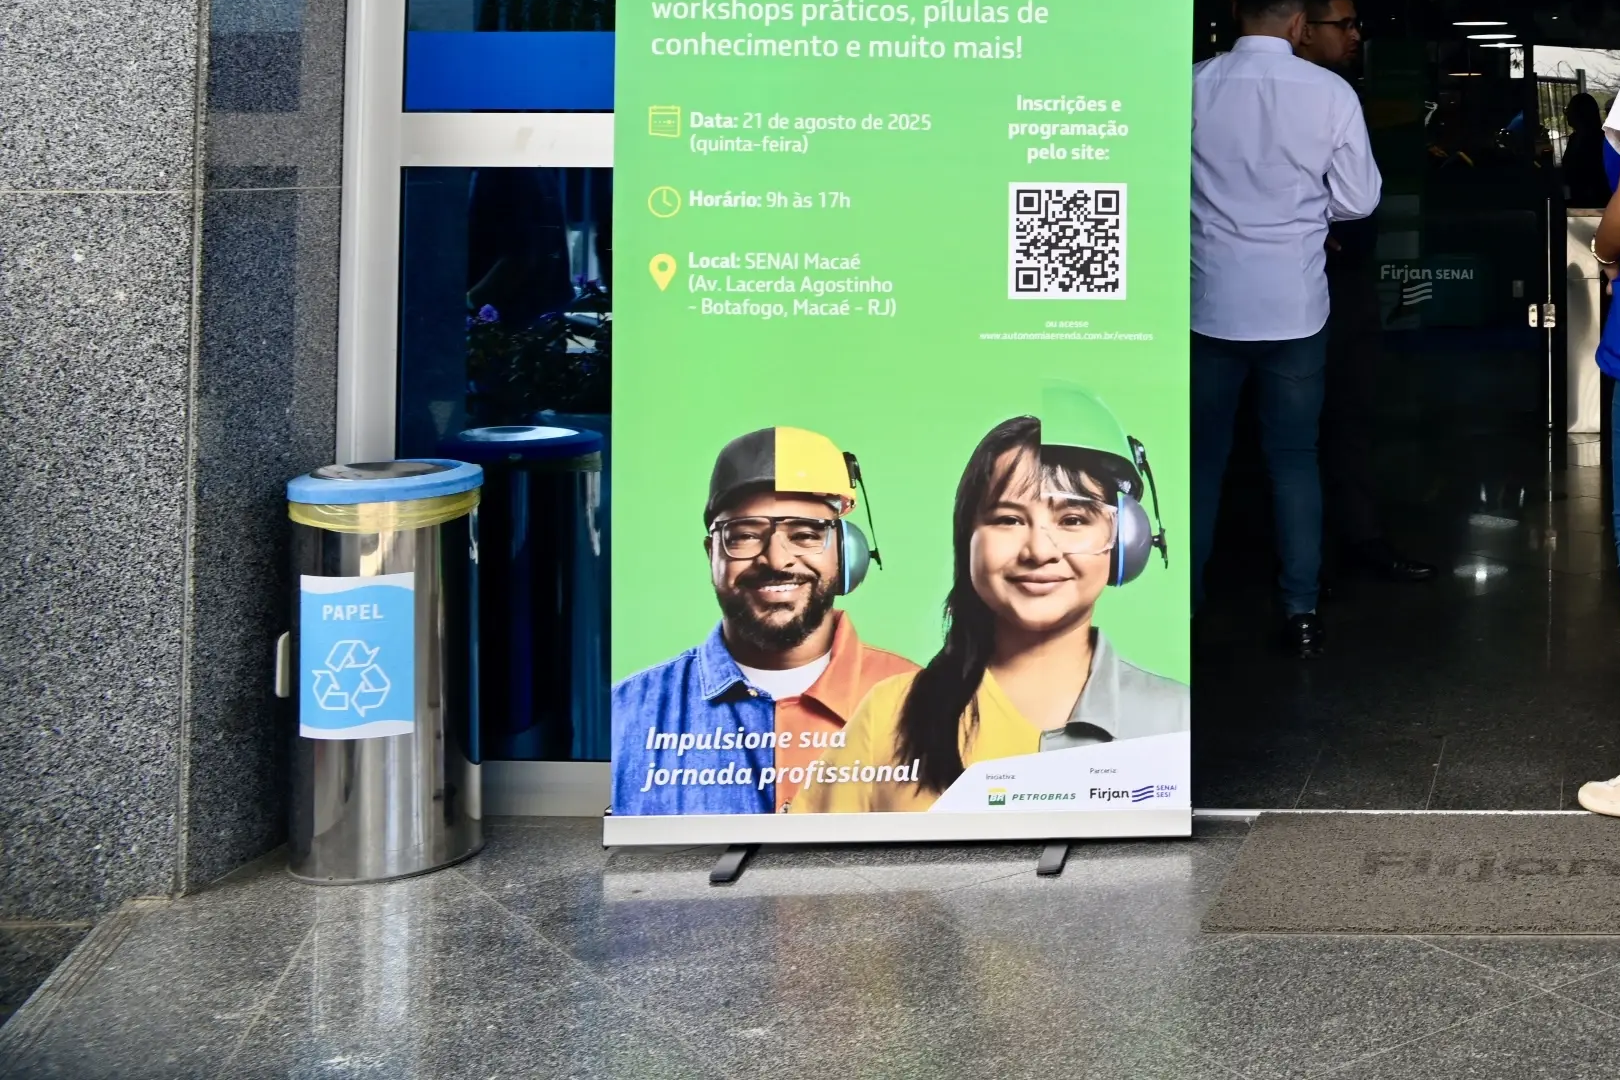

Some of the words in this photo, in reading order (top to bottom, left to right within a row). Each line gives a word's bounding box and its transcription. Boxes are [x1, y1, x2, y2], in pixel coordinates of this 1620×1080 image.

[1017, 0, 1048, 25] de
[652, 30, 840, 58] conhecimento
[846, 40, 861, 58] e
[869, 33, 946, 59] muito
[952, 34, 1022, 60] mais!
[1016, 94, 1107, 114] Inscrições
[1111, 99, 1122, 112] e
[690, 111, 738, 129] Data:
[743, 113, 762, 129] 21
[768, 113, 790, 130] de
[793, 115, 856, 133] agosto
[861, 114, 883, 130] de
[888, 114, 932, 131] 2025
[1008, 120, 1129, 140] programação
[689, 134, 809, 155] (quinta-feira)
[1027, 143, 1067, 163] pelo
[1071, 145, 1110, 161] site:
[689, 189, 762, 208] Horário:
[766, 191, 788, 208] 9h
[792, 192, 812, 208] às
[818, 192, 851, 208] 17h
[688, 251, 741, 269] Local:
[744, 252, 799, 270] SENAI
[804, 253, 861, 270] Macaé
[1380, 264, 1433, 283] Firjan
[1435, 269, 1474, 280] SENAI
[688, 275, 721, 294] (Av.
[726, 276, 795, 293] Lacerda
[800, 276, 893, 296] Agostinho
[701, 298, 788, 319] Botafogo,
[793, 299, 850, 316] Macaé
[868, 299, 897, 317] RJ)
[322, 603, 384, 621] PAPEL
[645, 726, 795, 754] Impulsione
[798, 731, 847, 749] sua
[641, 764, 753, 792] jornada
[758, 759, 920, 792] profissional
[1012, 792, 1077, 802] PETROBRAS
[1089, 788, 1130, 802] Firjan
